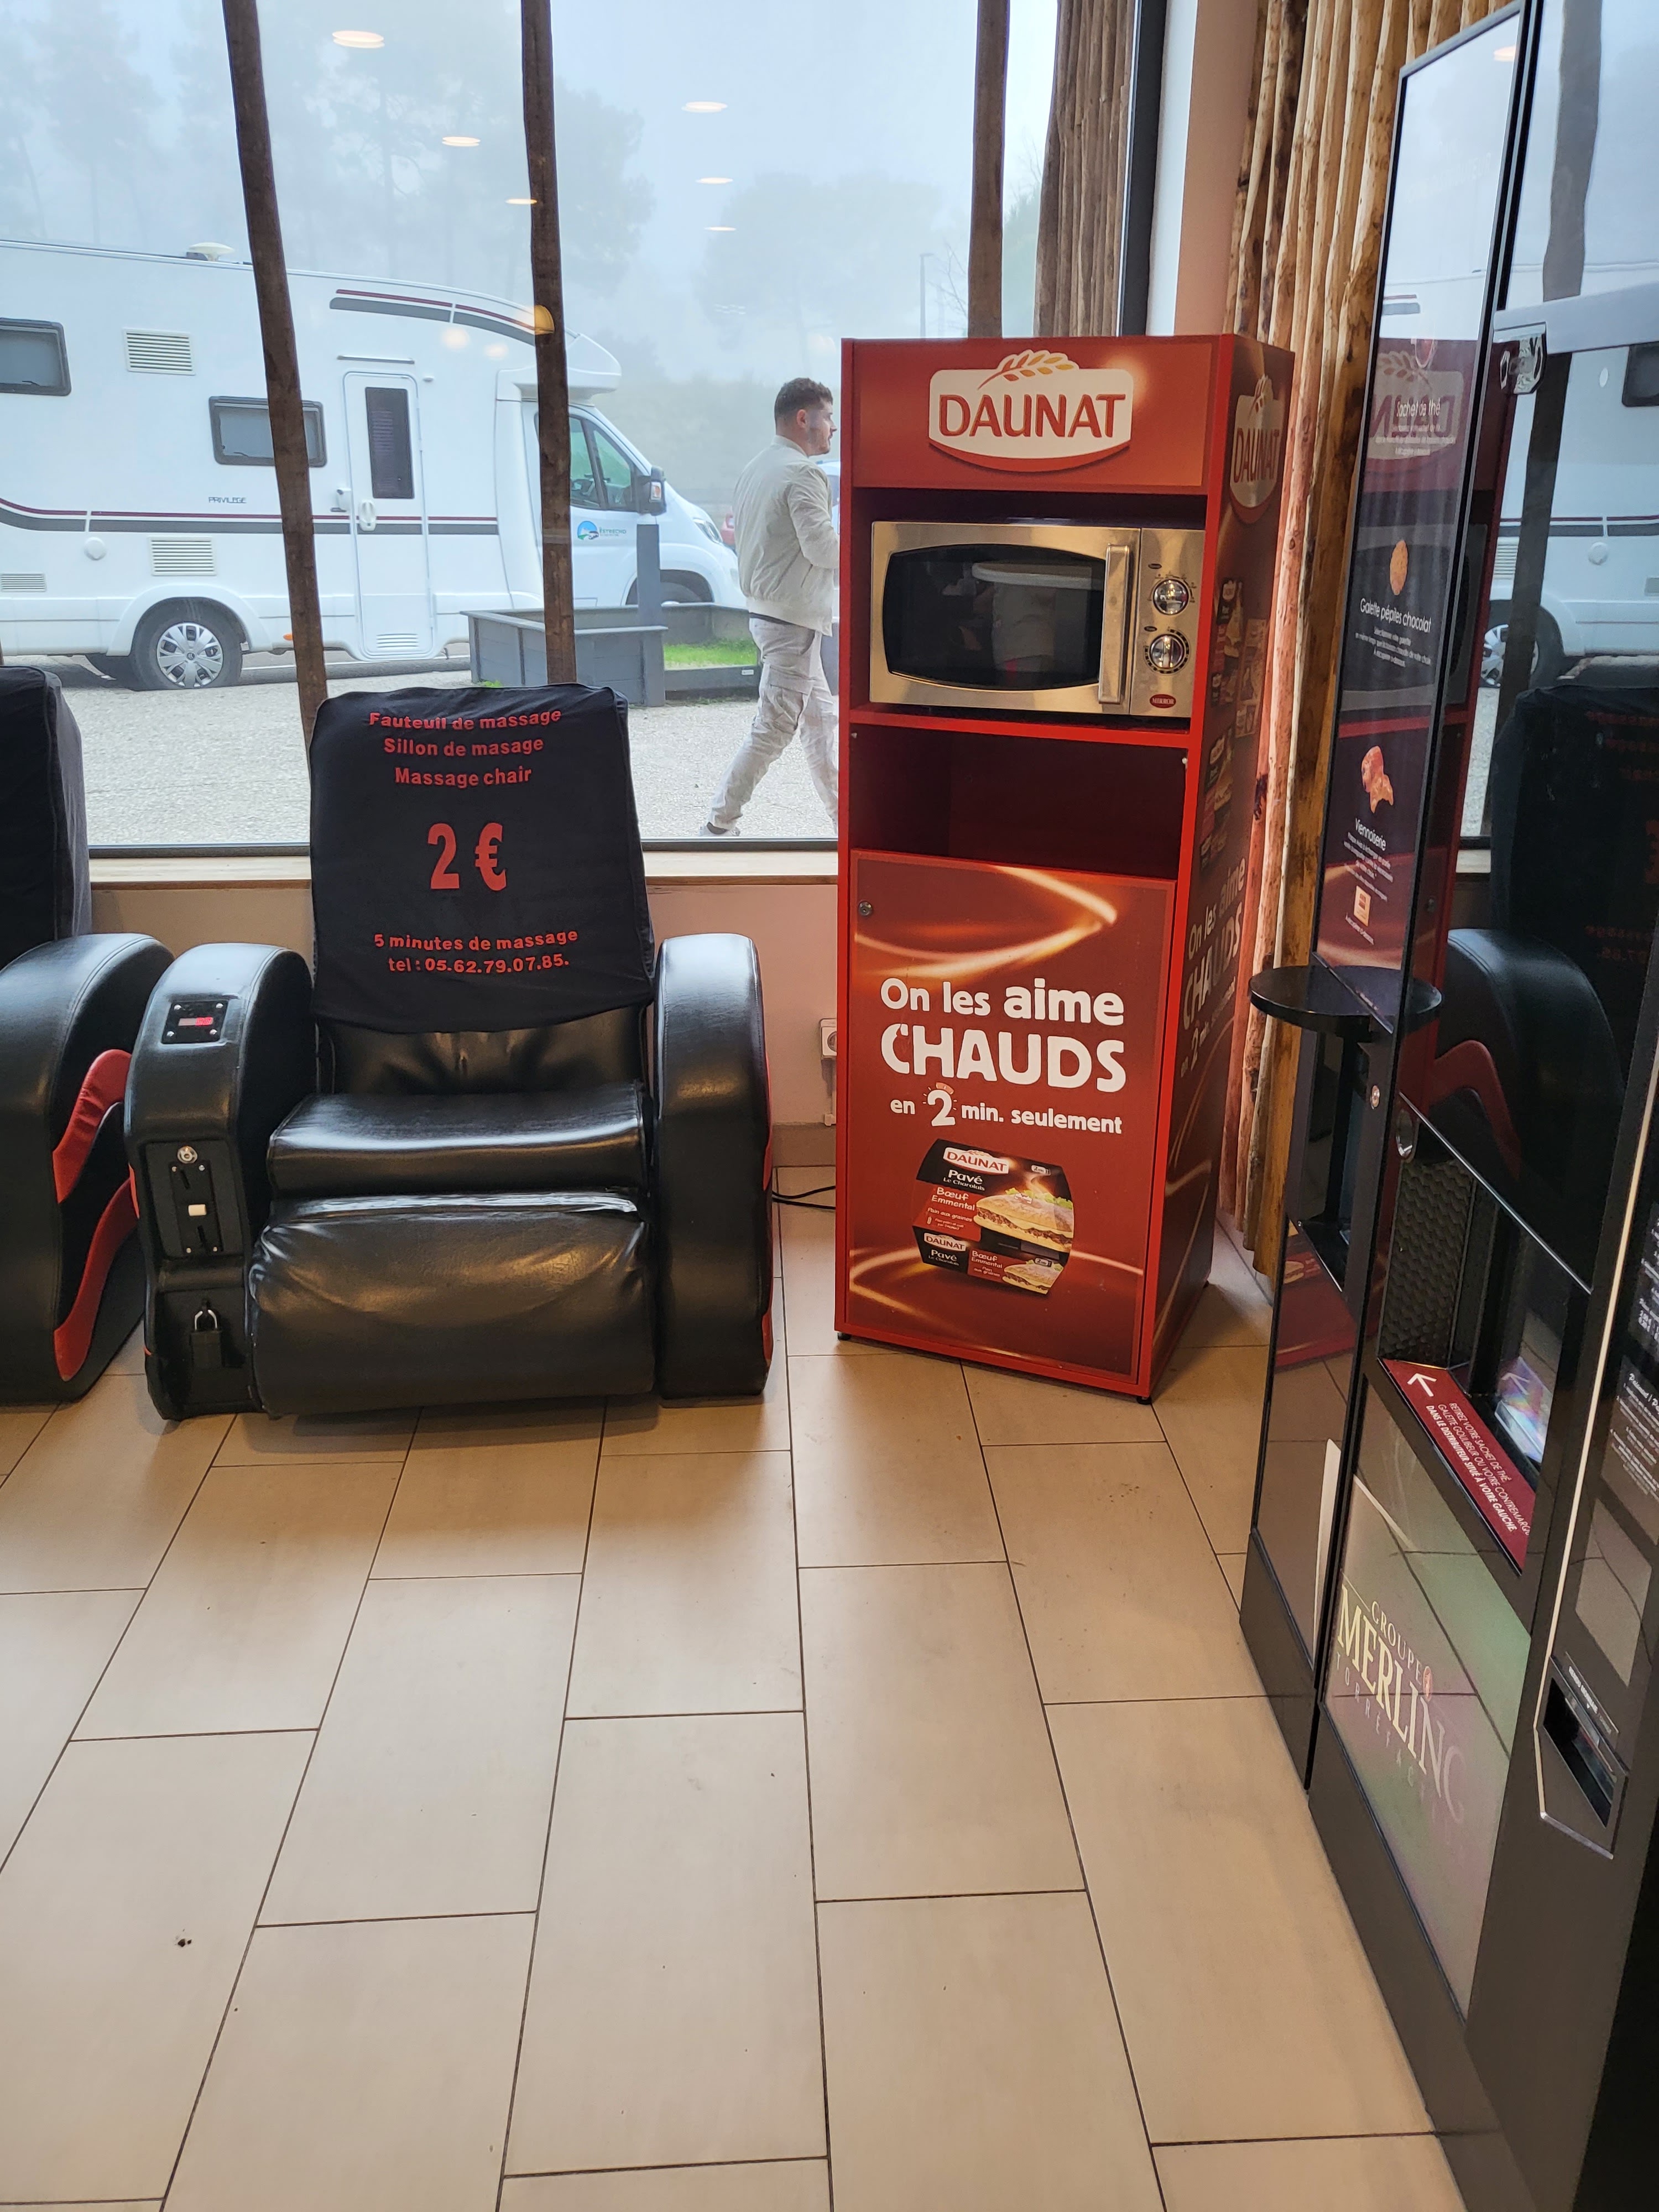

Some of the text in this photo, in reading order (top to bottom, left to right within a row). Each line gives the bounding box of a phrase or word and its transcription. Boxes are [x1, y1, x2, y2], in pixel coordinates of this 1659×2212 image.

[940, 393, 1126, 437] DAUNAT
[1234, 428, 1280, 483] DAUNAT
[1360, 598, 1432, 633] Galette pépites chocolat
[369, 710, 561, 730] Fauteuil de massage
[384, 737, 544, 757] Sillon de masage
[395, 765, 532, 789] Massage chair
[1355, 817, 1386, 851] Viennoiserie
[427, 822, 507, 891] 2 €
[374, 931, 577, 951] 5 minutes de massage
[1188, 922, 1202, 960] On
[424, 953, 569, 974] 05.62.79.07.85.
[880, 977, 1124, 1026] On les aime
[880, 1023, 1126, 1093] CHAUDS
[890, 1089, 1123, 1135] en 2 min. seulement
[947, 1151, 1007, 1172] DAUNAT
[948, 1169, 983, 1185] Pavé
[953, 1179, 985, 1191] Charolais
[931, 1195, 975, 1211] Emmental
[937, 1187, 969, 1201] Bœuf
[926, 1235, 964, 1250] DAUNAT
[931, 1249, 957, 1261] Pavé
[971, 1256, 1003, 1269] Emmental
[972, 1250, 998, 1261] Bœuf
[1426, 1405, 1442, 1421] DANS
[1440, 1427, 1470, 1462] DISTRIBUTEUR
[1479, 1483, 1498, 1503] VOTRE
[1438, 1404, 1459, 1426] GALETTE
[1474, 1457, 1487, 1467] OU
[1481, 1467, 1501, 1486] VOTRE
[1463, 1421, 1481, 1440] VOTRE
[1474, 1439, 1496, 1462] SACHET
[1490, 1461, 1503, 1470] DE
[1372, 1601, 1422, 1686] GROUPE
